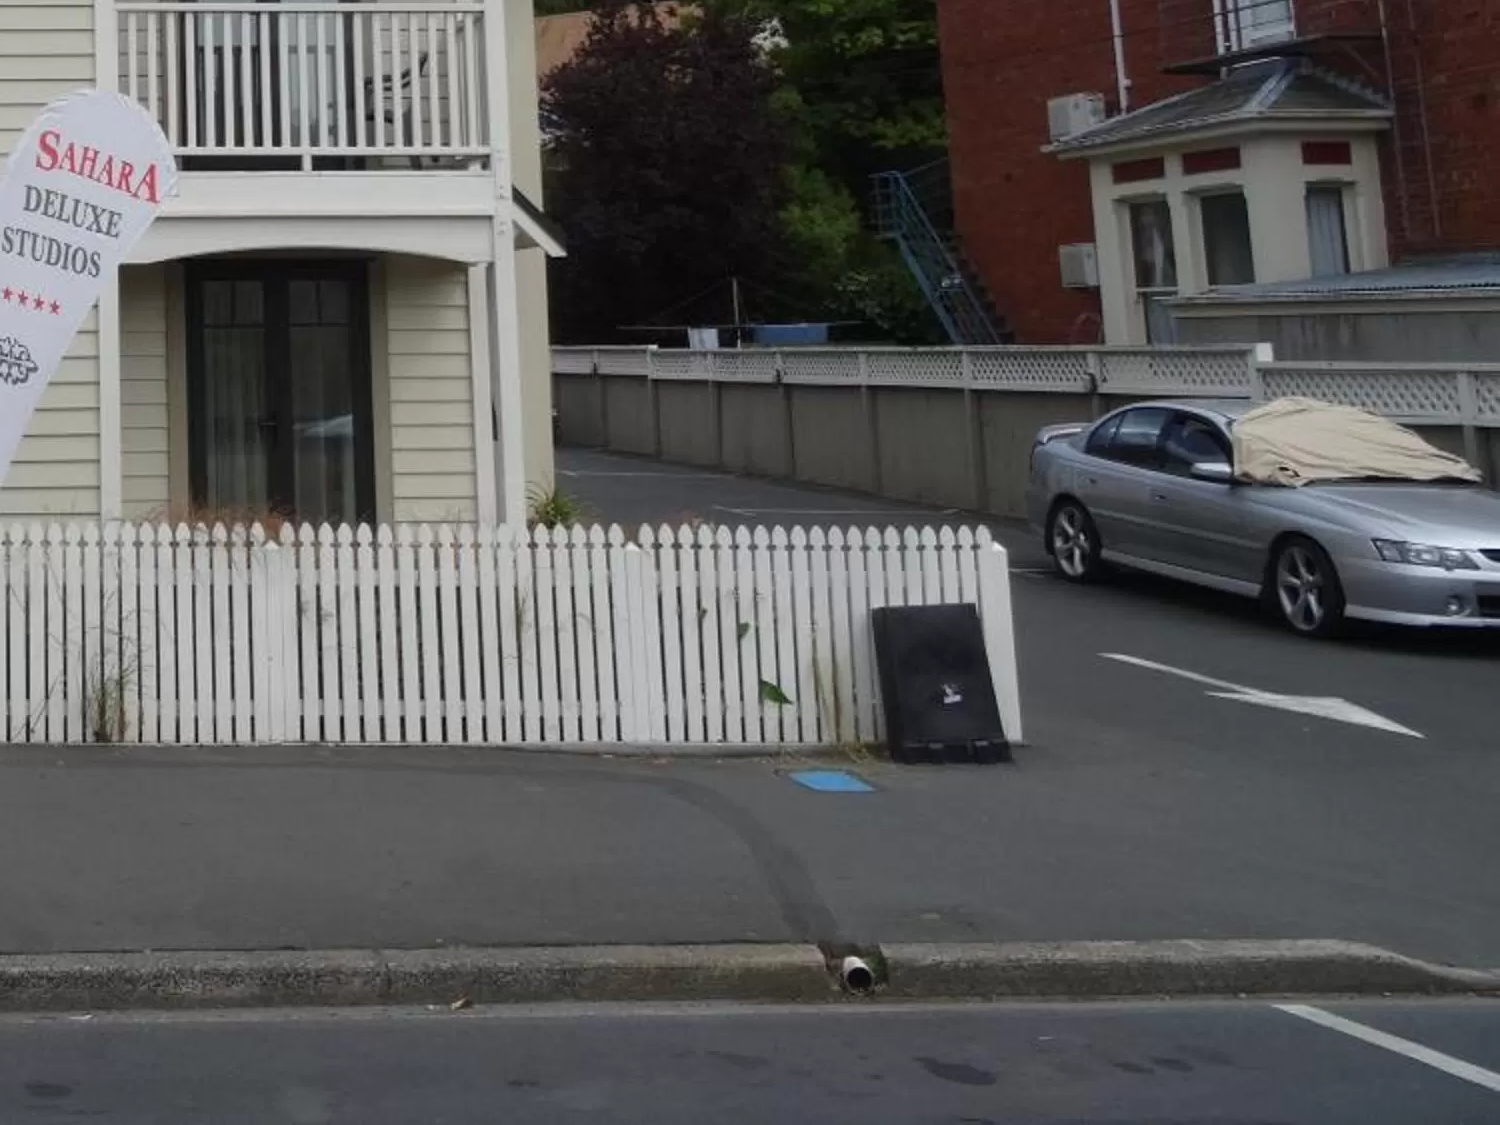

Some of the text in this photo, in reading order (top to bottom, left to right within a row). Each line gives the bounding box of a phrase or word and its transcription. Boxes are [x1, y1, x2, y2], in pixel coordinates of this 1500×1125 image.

[35, 129, 161, 204] SAHARA
[23, 184, 124, 239] DELUXE
[1, 226, 102, 278] STUDIOS
